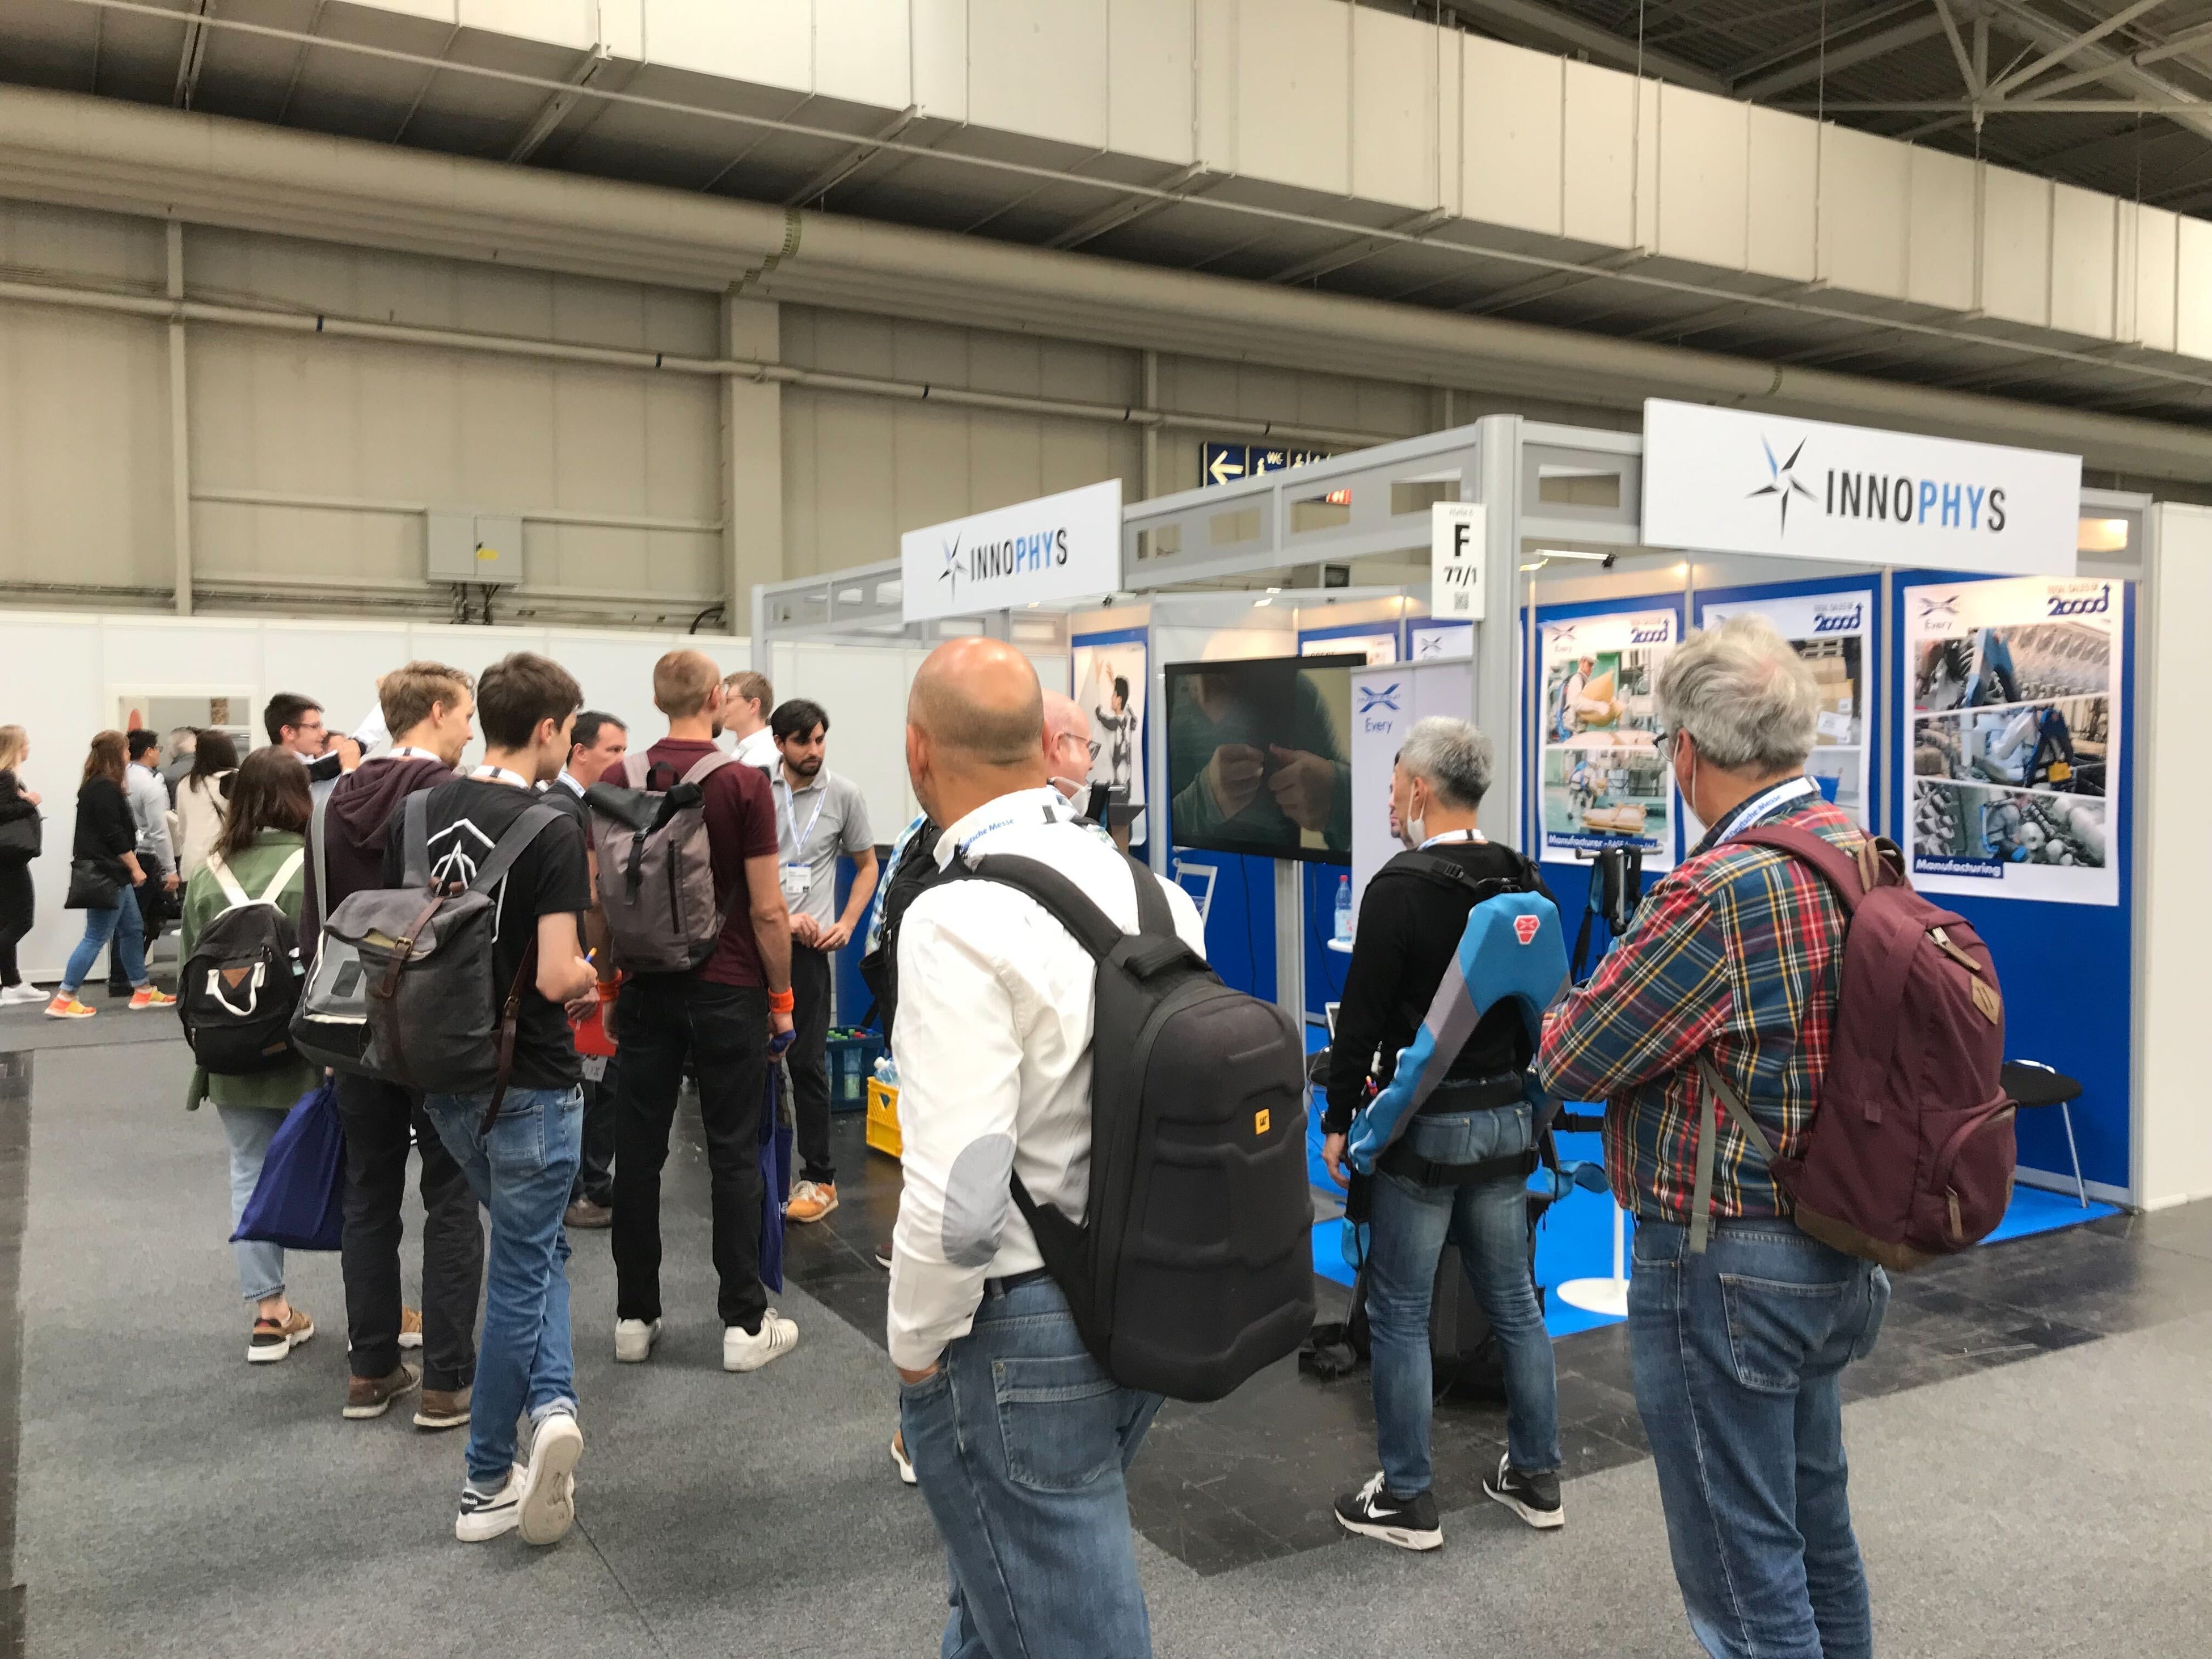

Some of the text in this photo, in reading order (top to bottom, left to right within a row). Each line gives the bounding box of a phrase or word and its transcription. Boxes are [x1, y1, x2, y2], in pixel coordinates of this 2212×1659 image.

[1267, 451, 1284, 465] WC
[1826, 469, 2007, 533] INNOPHYS
[1454, 522, 1470, 558] F
[970, 527, 1068, 582] INNOPHYS
[1443, 565, 1477, 588] 77/1
[1925, 618, 1953, 631] Every
[1365, 717, 1393, 734] Every
[1758, 794, 1783, 813] Messe
[989, 818, 1014, 832] Messe
[1916, 859, 2001, 877] Manufacturing
